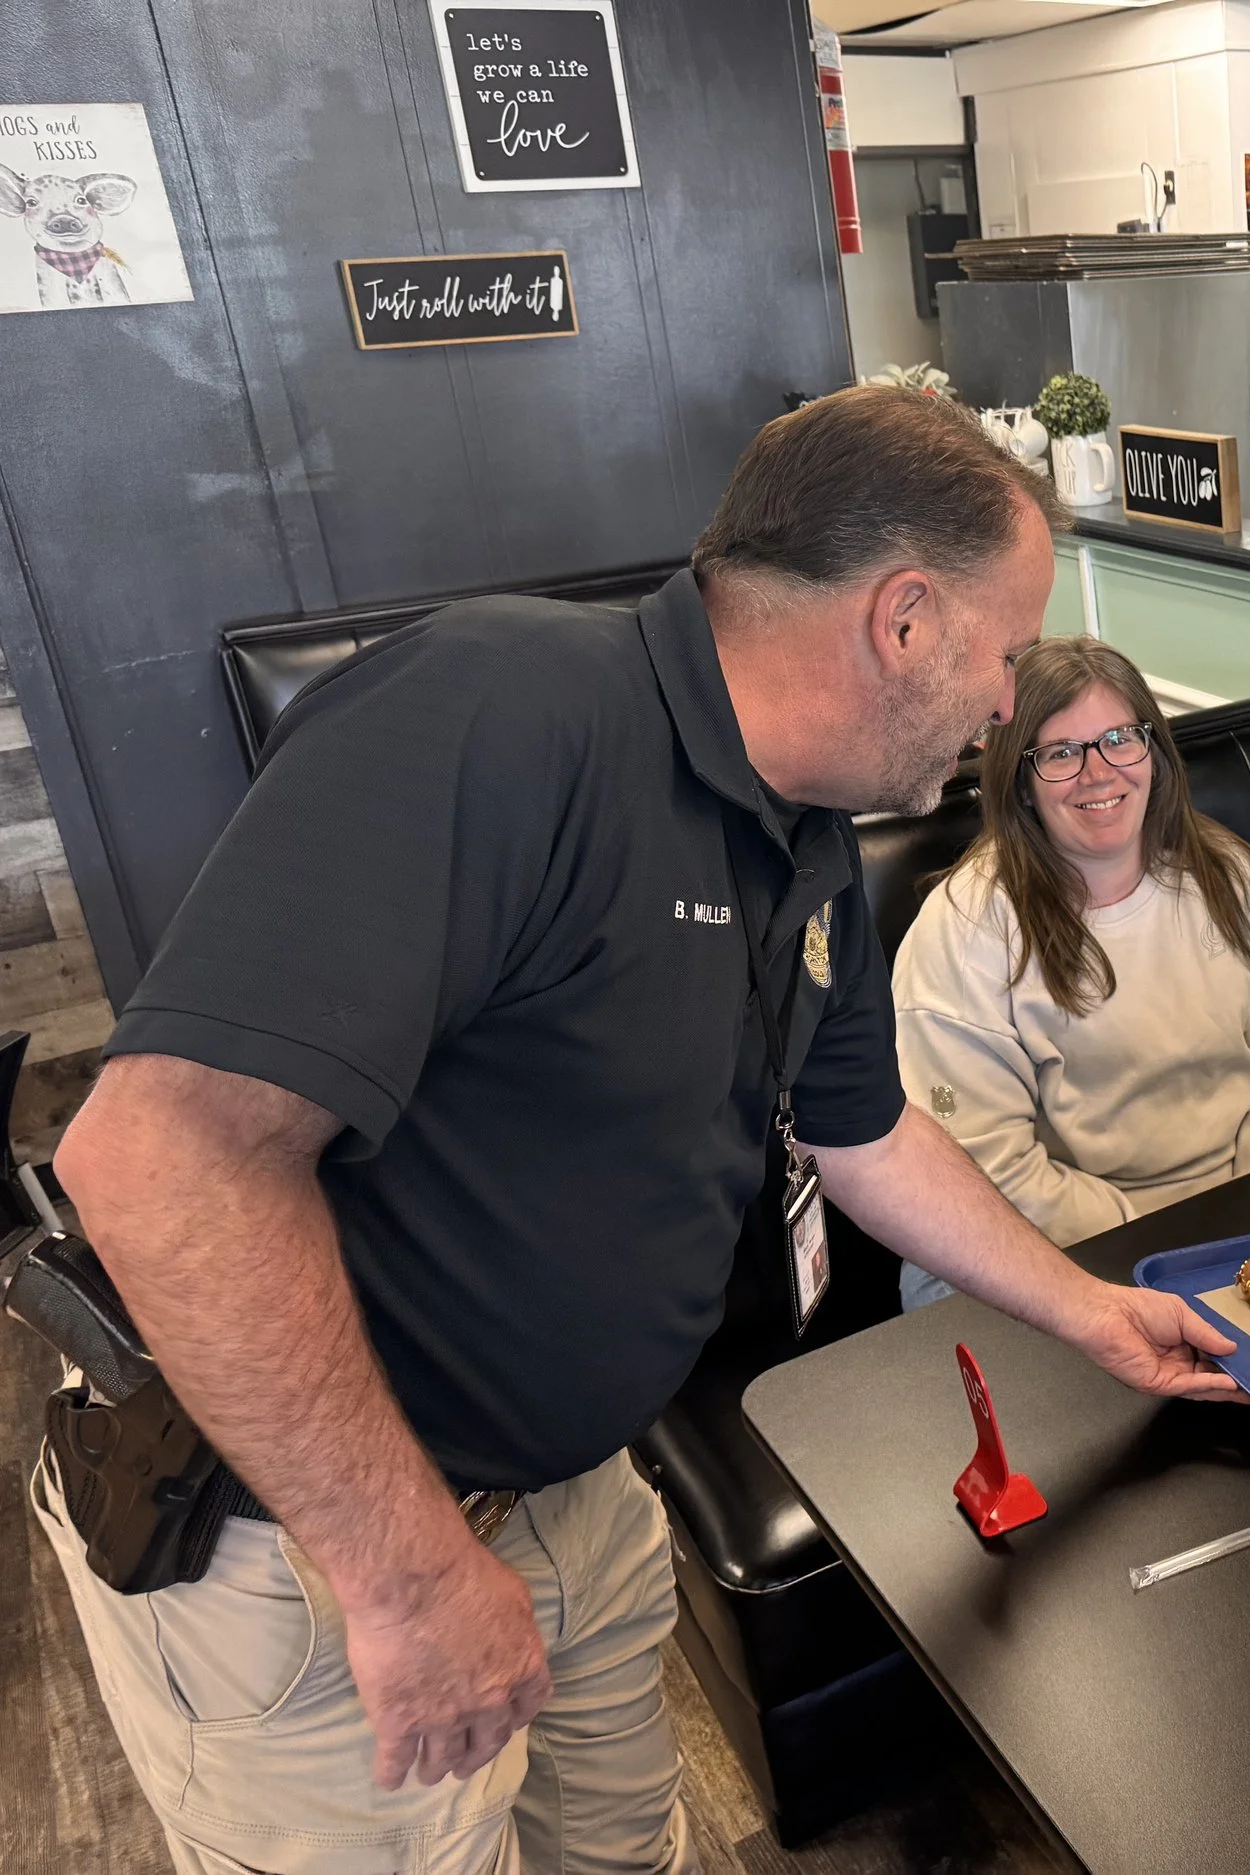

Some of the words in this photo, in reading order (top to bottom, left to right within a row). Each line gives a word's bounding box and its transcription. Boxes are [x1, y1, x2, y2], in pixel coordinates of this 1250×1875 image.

[466, 33, 522, 51] let's
[473, 64, 523, 82] grow
[529, 64, 542, 77] a
[547, 60, 589, 77] life
[477, 90, 505, 103] we
[516, 89, 554, 103] can
[45, 115, 80, 135] and
[487, 100, 590, 157] love
[33, 140, 97, 160] KISSES
[364, 279, 419, 320] Just
[420, 276, 464, 319] roll
[469, 273, 522, 316] with
[525, 276, 549, 315] it
[1125, 448, 1166, 502] OLIVE
[1167, 454, 1198, 507] YOU
[675, 900, 689, 920] B.
